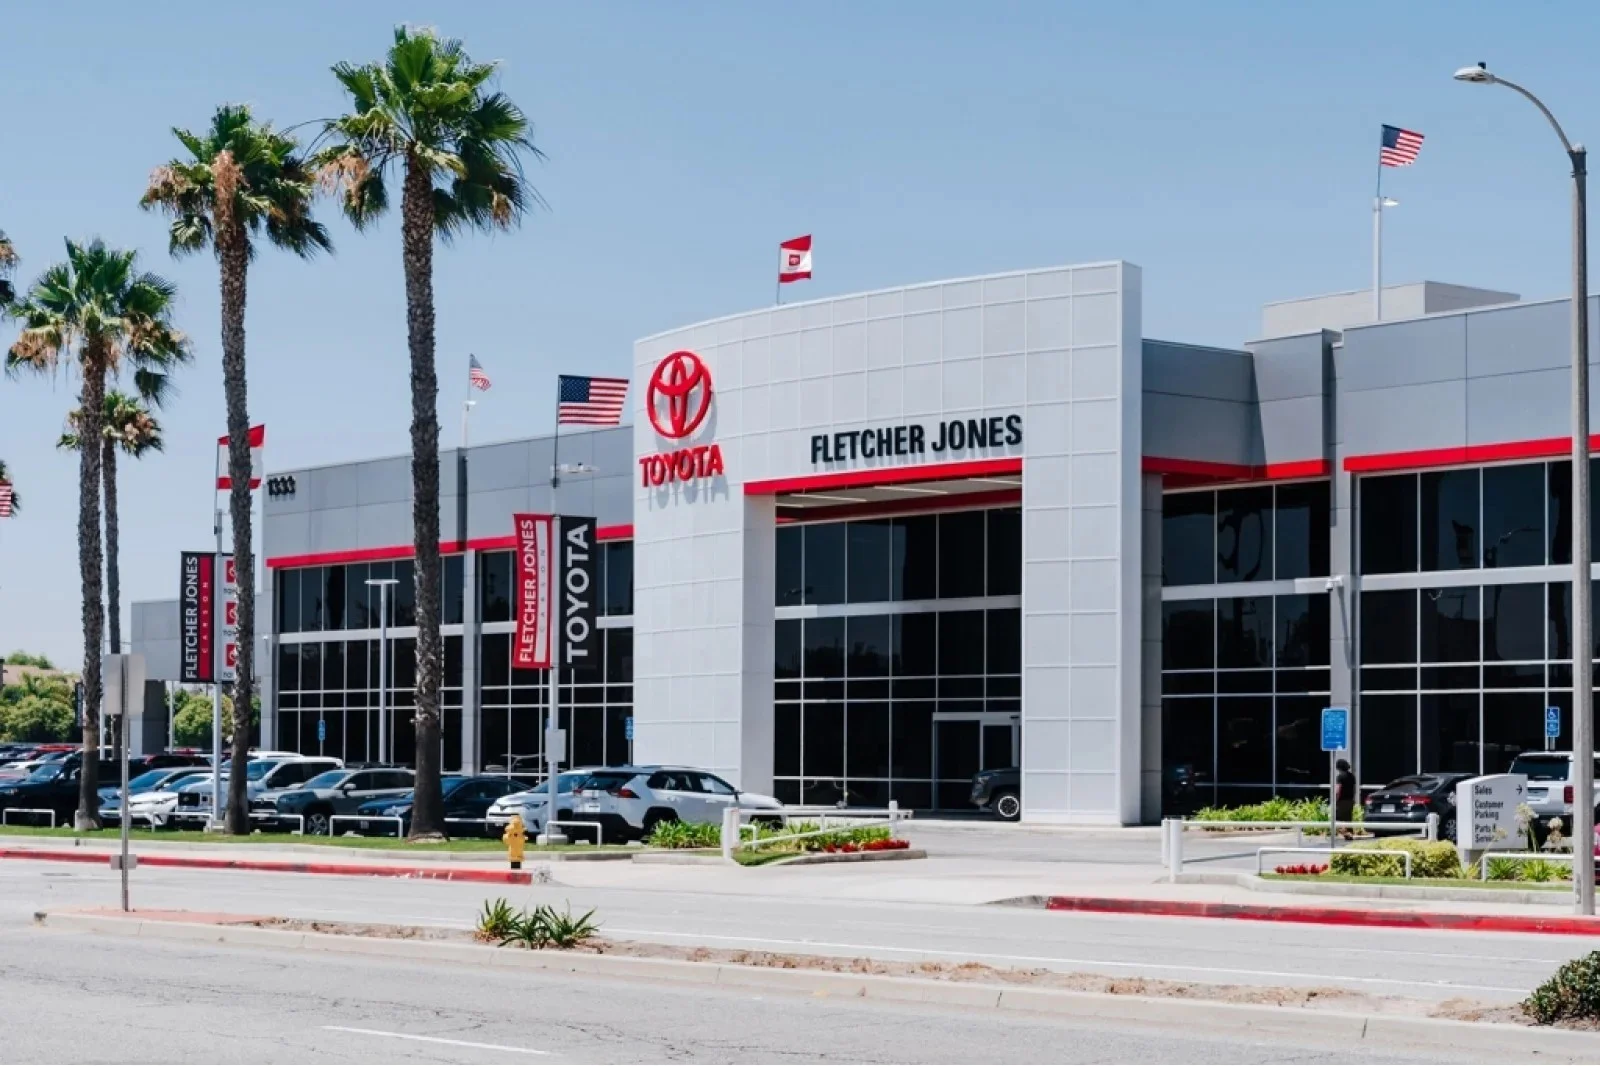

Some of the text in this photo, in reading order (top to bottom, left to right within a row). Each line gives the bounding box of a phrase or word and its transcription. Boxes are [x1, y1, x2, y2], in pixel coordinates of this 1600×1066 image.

[810, 413, 1023, 465] FLETCHER JONES
[639, 444, 724, 488] TOYOTA
[267, 475, 296, 496] 1333
[519, 519, 537, 662] FLETCHER JONES
[566, 524, 590, 664] TOYOTA
[185, 556, 198, 679] FLETCHER JONES
[1475, 785, 1492, 795] Sales
[1475, 800, 1504, 809] Customer
[1475, 810, 1499, 820] Parking
[1475, 823, 1491, 833] Parts
[1475, 834, 1499, 843] Servi
